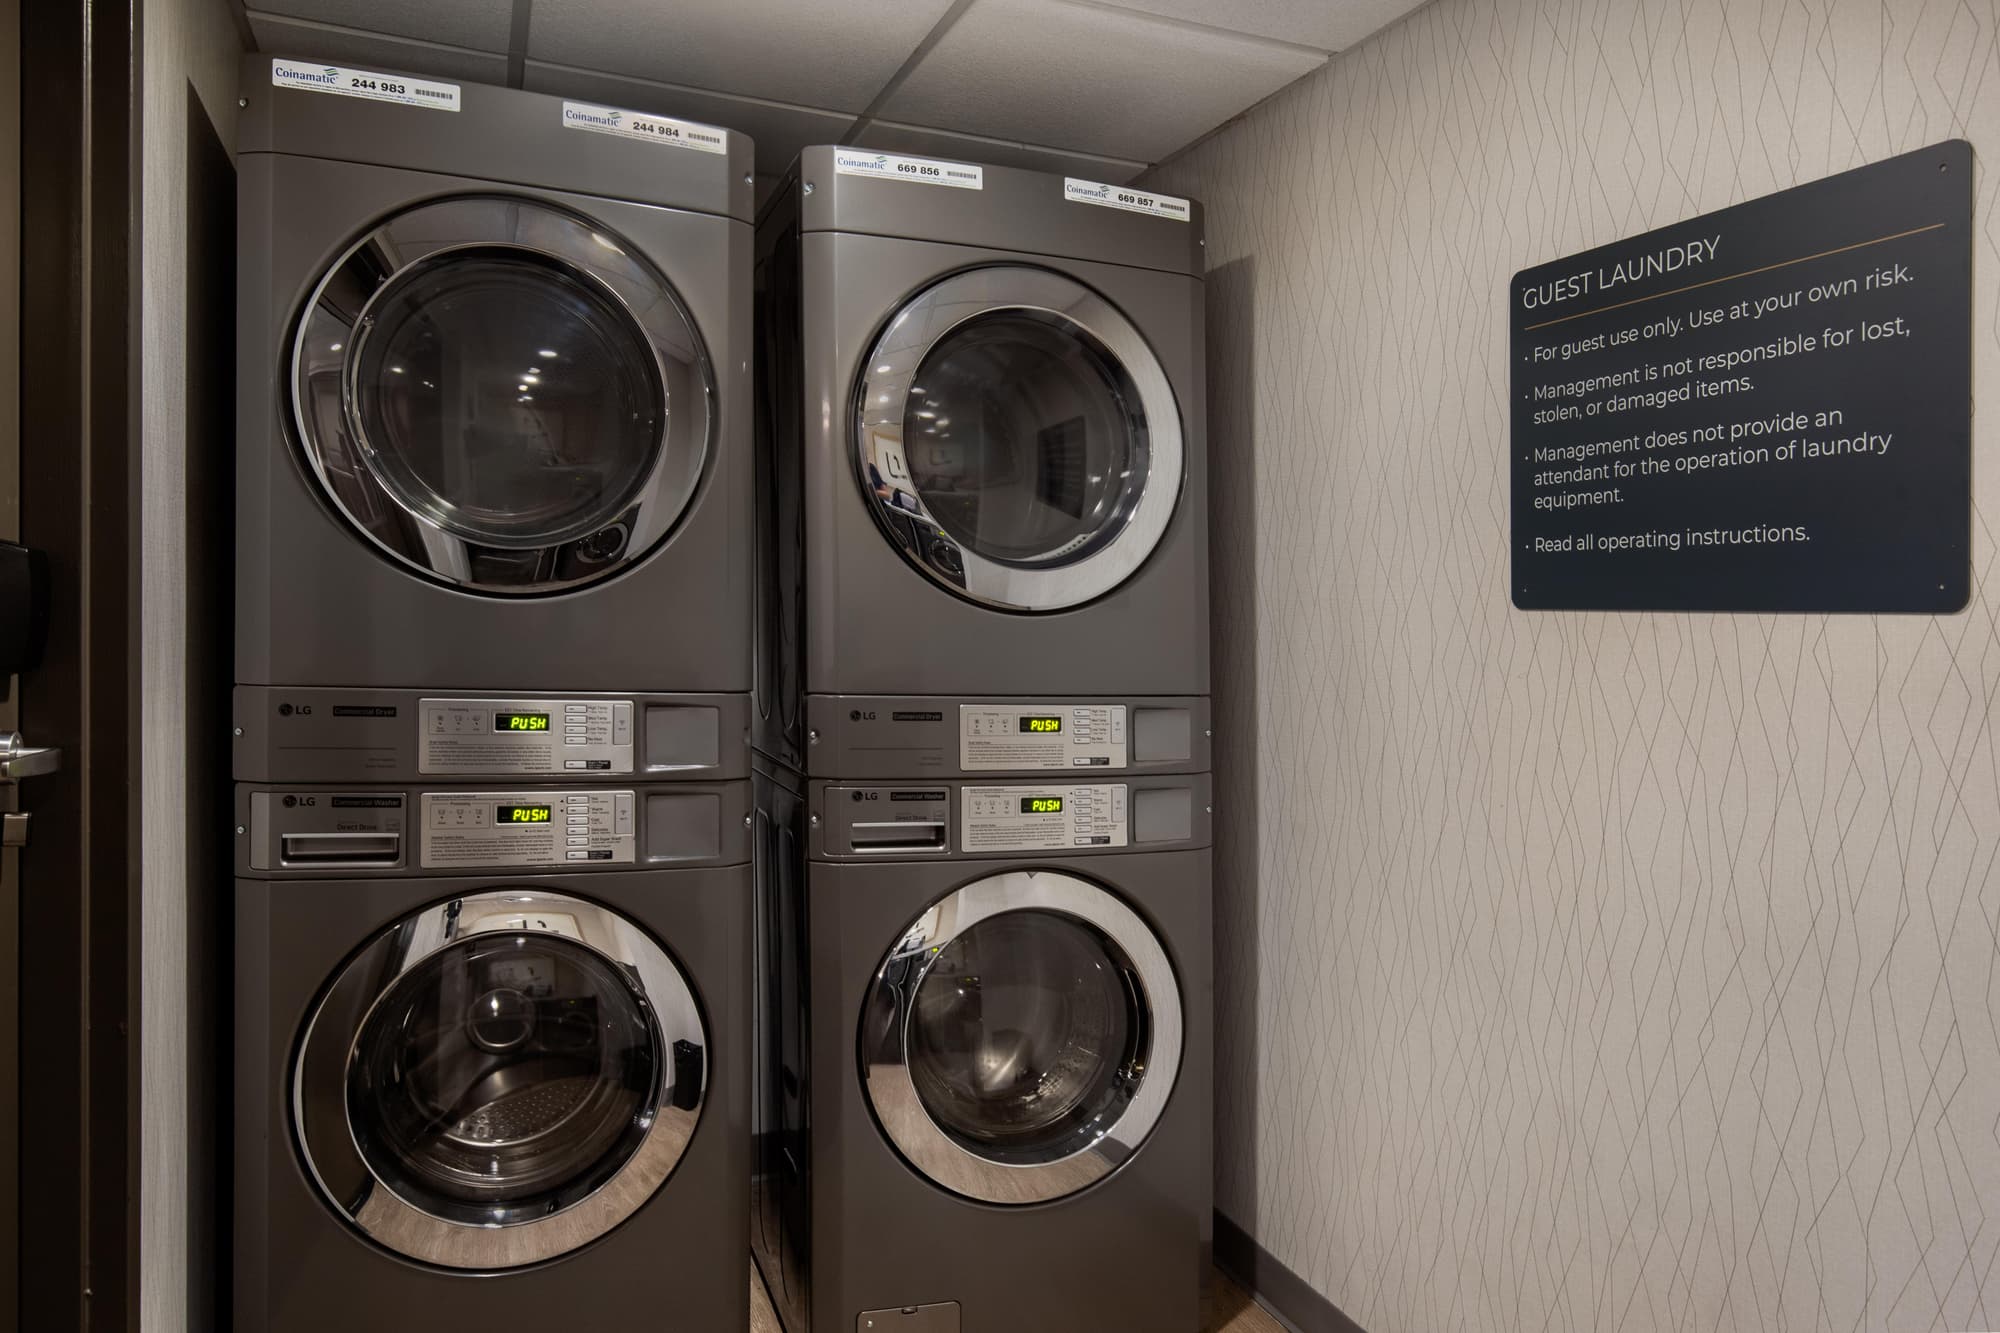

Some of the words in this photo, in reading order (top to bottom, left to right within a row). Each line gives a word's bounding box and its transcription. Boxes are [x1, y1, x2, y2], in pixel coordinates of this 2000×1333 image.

[275, 67, 336, 84] Coinamatic
[351, 78, 377, 91] 244
[381, 80, 406, 94] 983
[565, 109, 619, 127] Coinamatic
[633, 121, 654, 133] 244
[658, 126, 680, 138] 984
[837, 157, 885, 170] Coinamatic
[897, 163, 917, 174] 669
[920, 165, 940, 176] 856
[1066, 184, 1107, 199] Coinamatic
[1118, 193, 1135, 204] 669
[1137, 197, 1154, 207] 857
[1523, 271, 1593, 309] GUEST
[1599, 234, 1720, 290] LAUNDRY
[1534, 346, 1558, 363] For
[1561, 334, 1605, 360] guest
[1610, 328, 1639, 346] use
[1643, 316, 1683, 338] only.
[1689, 309, 1724, 328] Use
[1729, 301, 1750, 320] at
[1754, 290, 1802, 319] your
[1808, 279, 1857, 302] own
[1866, 263, 1914, 290] risk.
[1534, 367, 1641, 401] Management
[1645, 364, 1658, 381] is
[1663, 357, 1693, 378] not
[1699, 333, 1816, 371] responsible
[1822, 328, 1854, 349] for
[1862, 317, 1910, 342] lost,
[1534, 404, 1582, 424] stolen,
[1586, 401, 1603, 416] or
[1606, 382, 1690, 413] damaged
[1696, 377, 1754, 398] items.
[1535, 435, 1640, 463] Management
[1644, 431, 1688, 449] does
[1693, 424, 1725, 443] not
[1731, 411, 1809, 443] provide
[1815, 410, 1842, 427] an
[1534, 464, 1610, 486] attendant
[1613, 460, 1637, 478] for
[1640, 457, 1670, 475] the
[1675, 446, 1769, 474] operation
[1775, 439, 1797, 461] of
[1803, 431, 1892, 458] laundry
[1534, 488, 1624, 512] equipment.
[1535, 535, 1572, 552] Read
[1576, 533, 1593, 551] all
[1598, 529, 1680, 553] operating
[1687, 524, 1810, 546] instructions.
[295, 705, 312, 715] LG
[863, 711, 877, 721] LG
[510, 716, 546, 729] PUSH
[1030, 720, 1059, 731] PUSH
[299, 796, 316, 807] LG
[865, 792, 878, 801] LG
[1032, 800, 1060, 812] PUSH
[512, 808, 548, 822] PUSH
